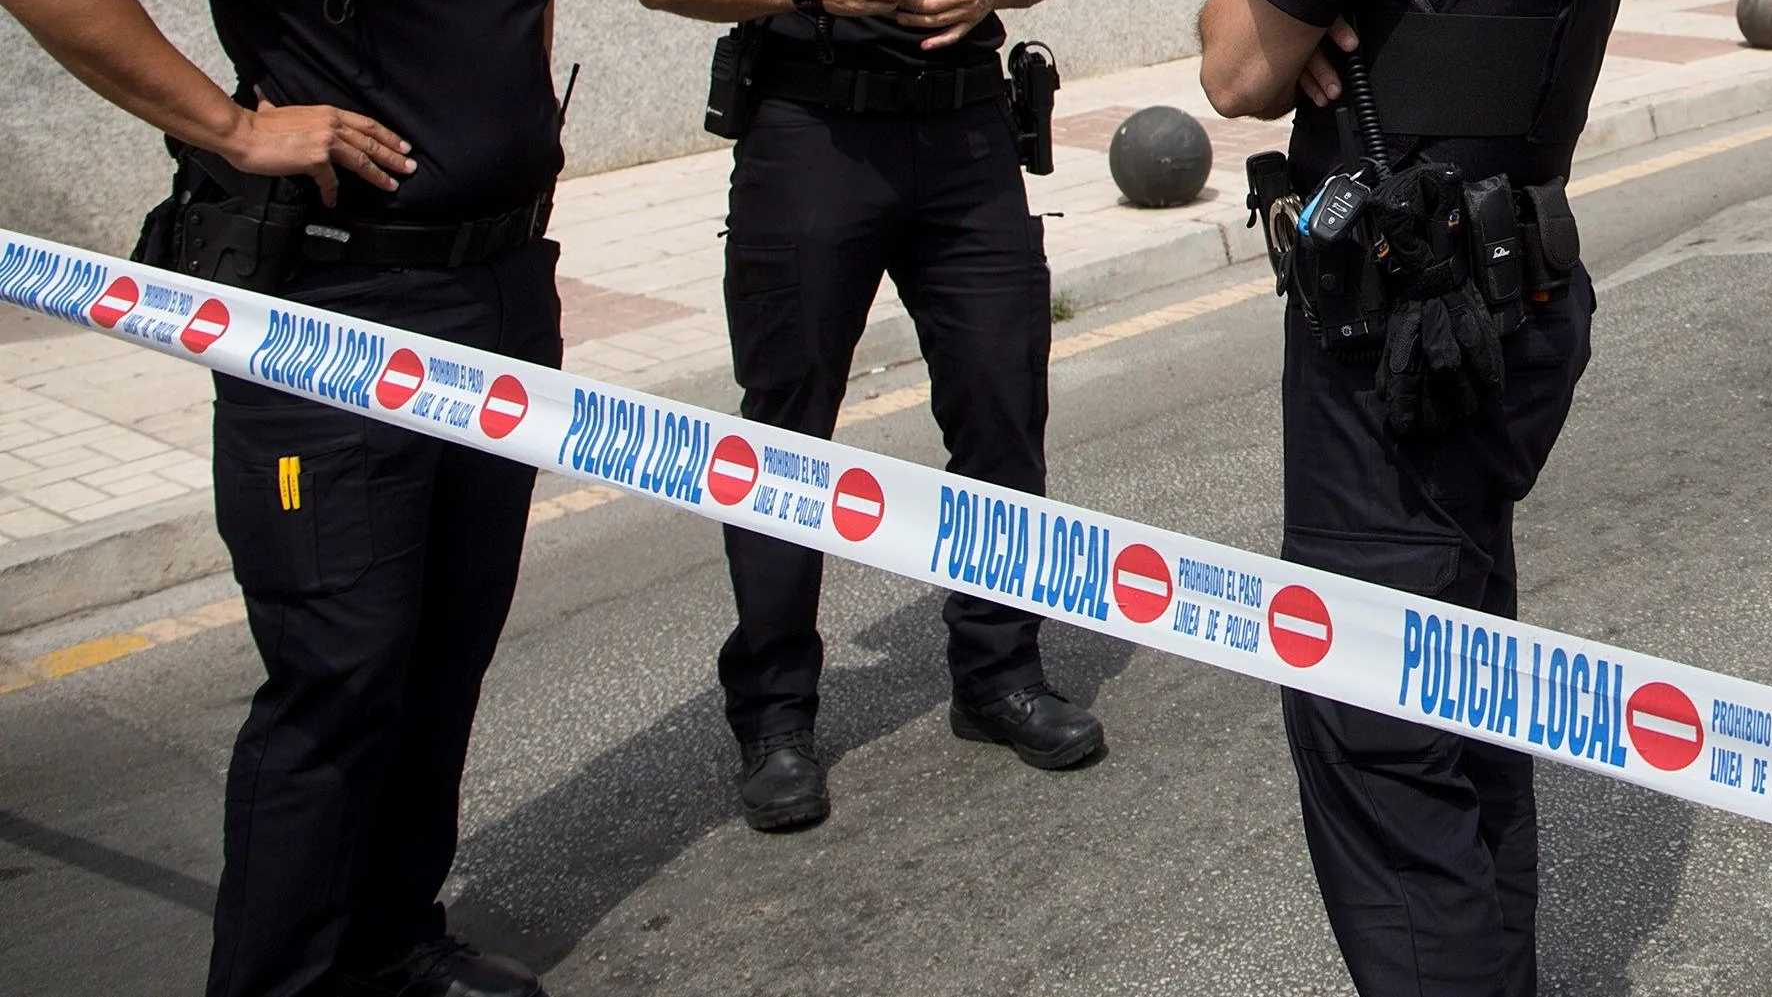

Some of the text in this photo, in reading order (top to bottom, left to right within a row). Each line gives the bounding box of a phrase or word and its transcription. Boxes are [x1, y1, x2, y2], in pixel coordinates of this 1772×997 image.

[0, 243, 108, 327] POLICIA LOCAL
[250, 309, 385, 409] POLICIA LOCAL
[427, 357, 484, 394] PROHIBIDO EL PASO
[412, 391, 475, 429] LINEA DE POLICIA
[559, 388, 710, 505] POLICIA LOCAL
[763, 446, 830, 489] PROHIBIDO EL PASO
[753, 485, 825, 529] LINEA DE POLICIA
[931, 485, 1110, 622] POLICIA LOCAL
[1178, 557, 1262, 609] PROHIBIDO EL PASO
[1173, 600, 1261, 653] LINEA DE POLICIA
[1398, 609, 1628, 769] POLICIA LOCAL
[1712, 699, 1772, 747] PROHIBIDO
[1709, 747, 1742, 788] LINEA
[1750, 758, 1767, 794] DE
